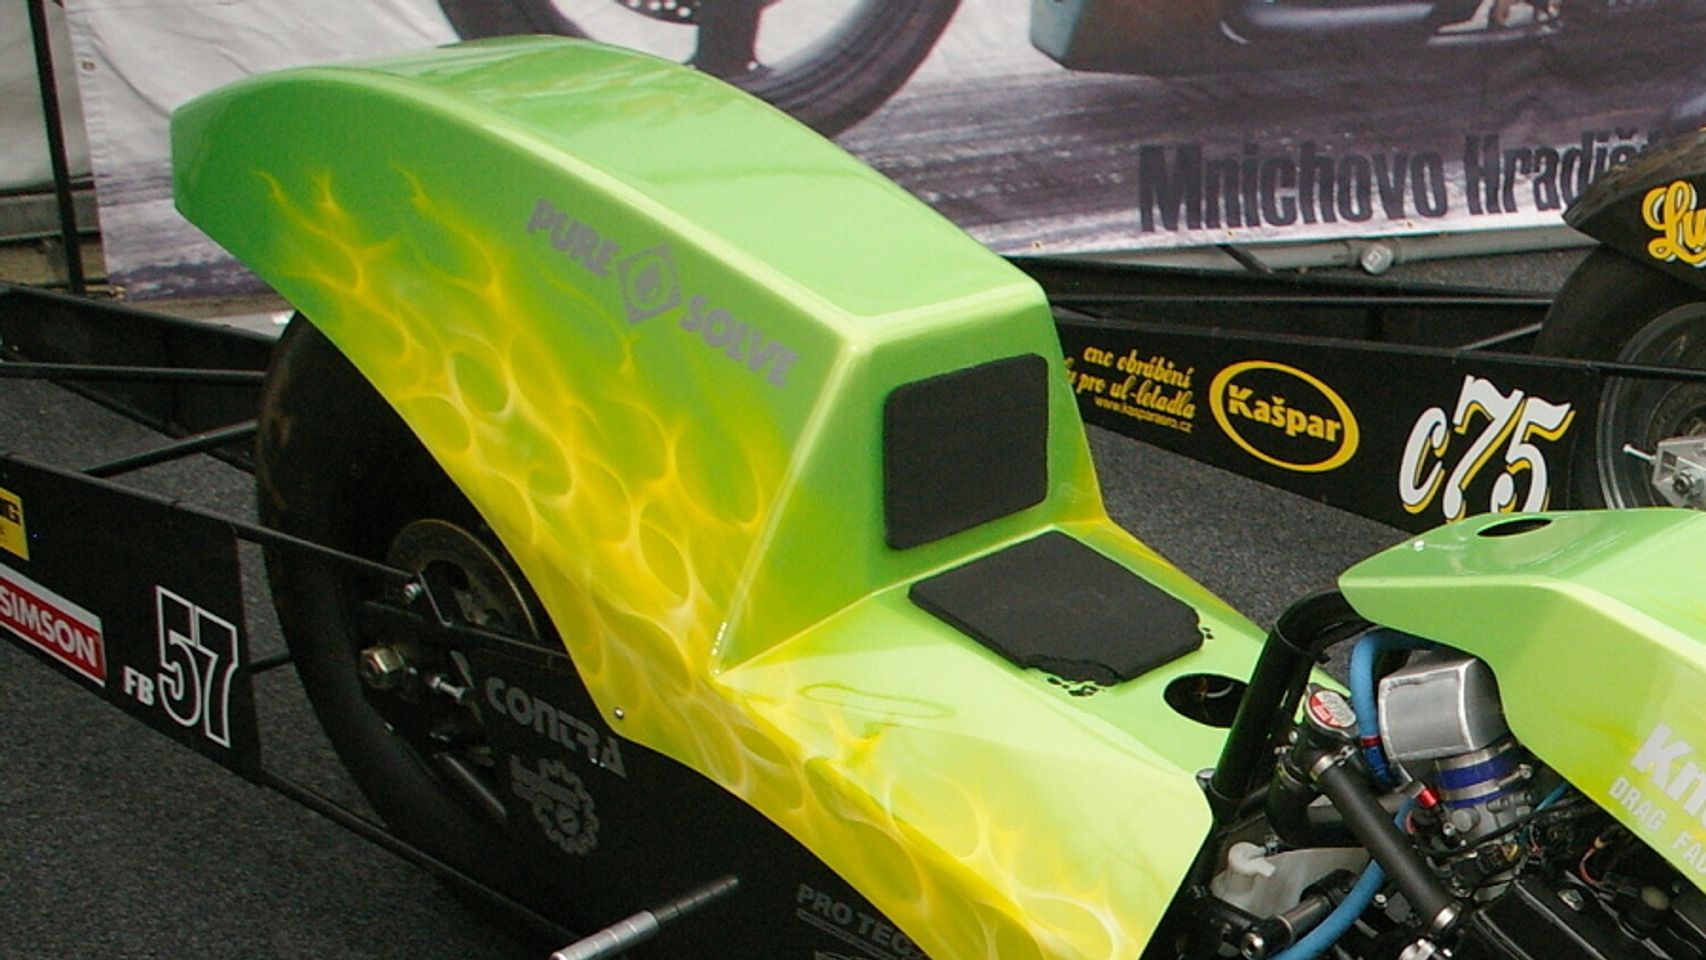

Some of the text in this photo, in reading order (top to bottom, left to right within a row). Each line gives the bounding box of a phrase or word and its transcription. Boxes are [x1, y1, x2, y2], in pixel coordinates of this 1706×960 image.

[1138, 139, 1448, 232] Mnichovo
[526, 196, 798, 388] PURE SOLVE
[1228, 384, 1341, 442] Kašpar
[0, 585, 97, 668] SIMSON
[123, 584, 240, 749] FB 57
[1608, 776, 1667, 833] DRAG
